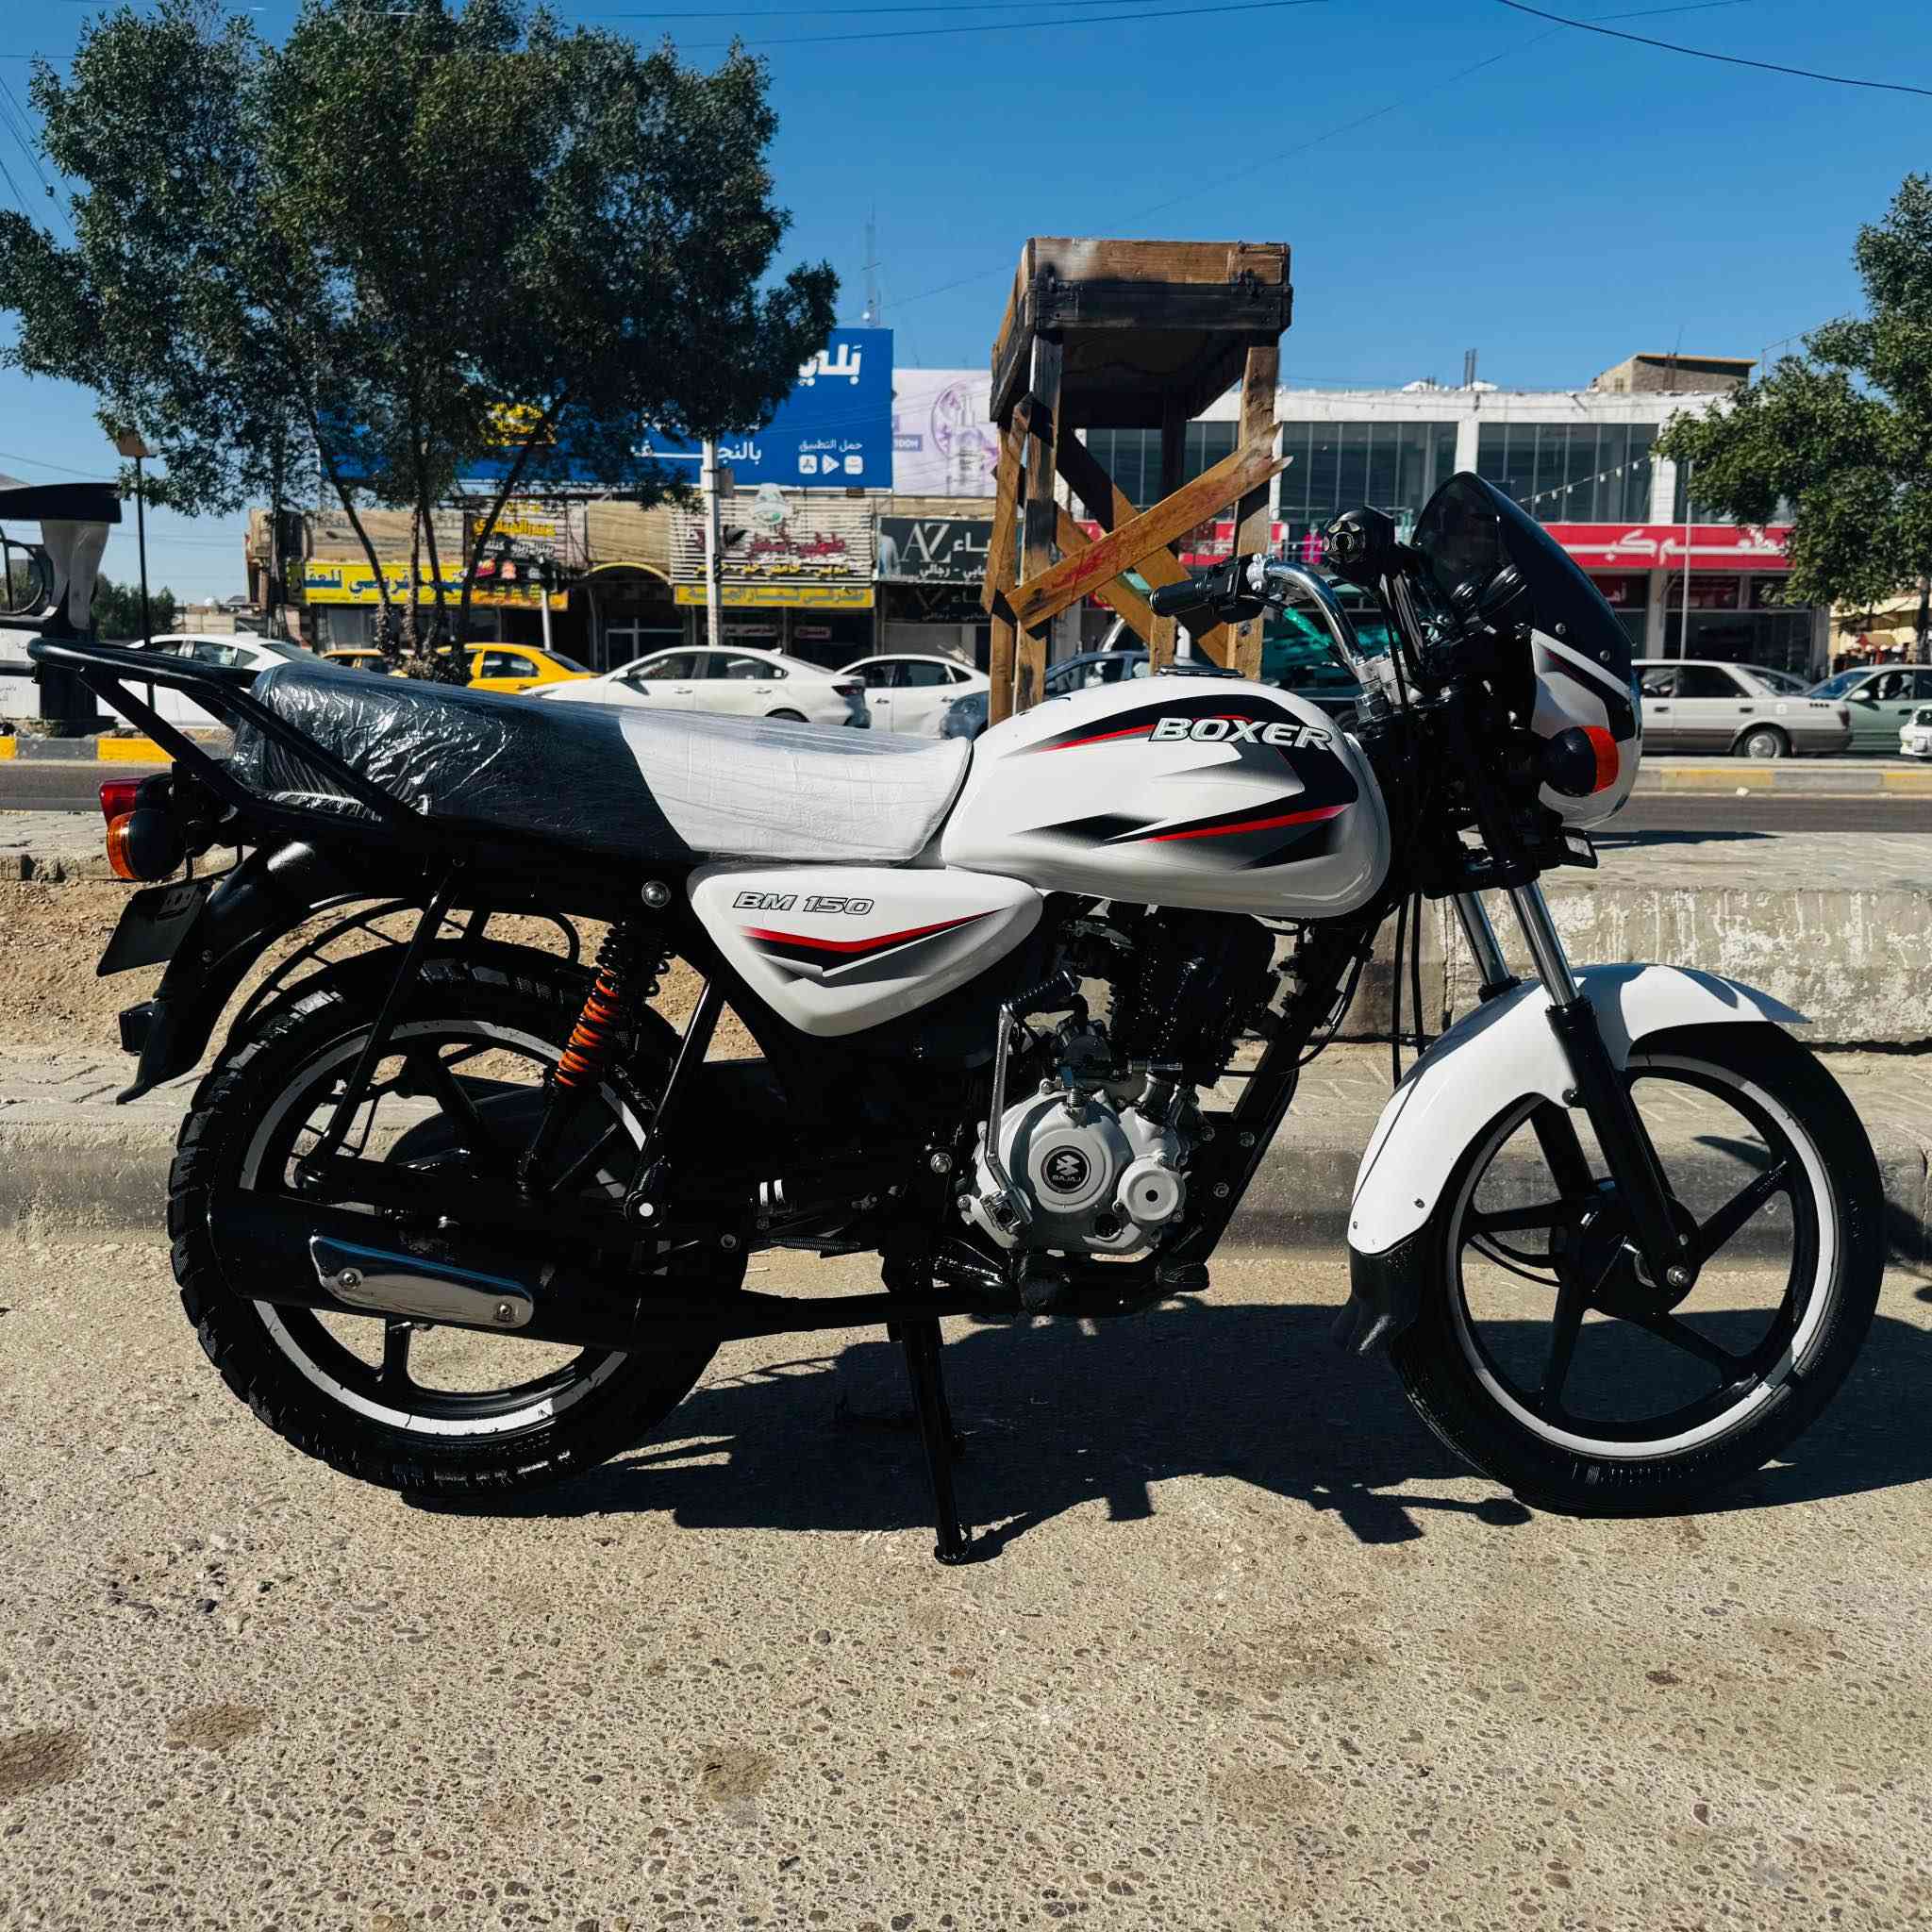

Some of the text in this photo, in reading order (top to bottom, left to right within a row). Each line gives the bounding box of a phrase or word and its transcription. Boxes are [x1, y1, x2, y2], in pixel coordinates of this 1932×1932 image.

[798, 439, 863, 452] حمل التطبيق
[898, 523, 951, 563] AZ
[919, 564, 950, 578] رجالي
[1149, 717, 1332, 751] BOXER
[732, 891, 874, 916] BM 150
